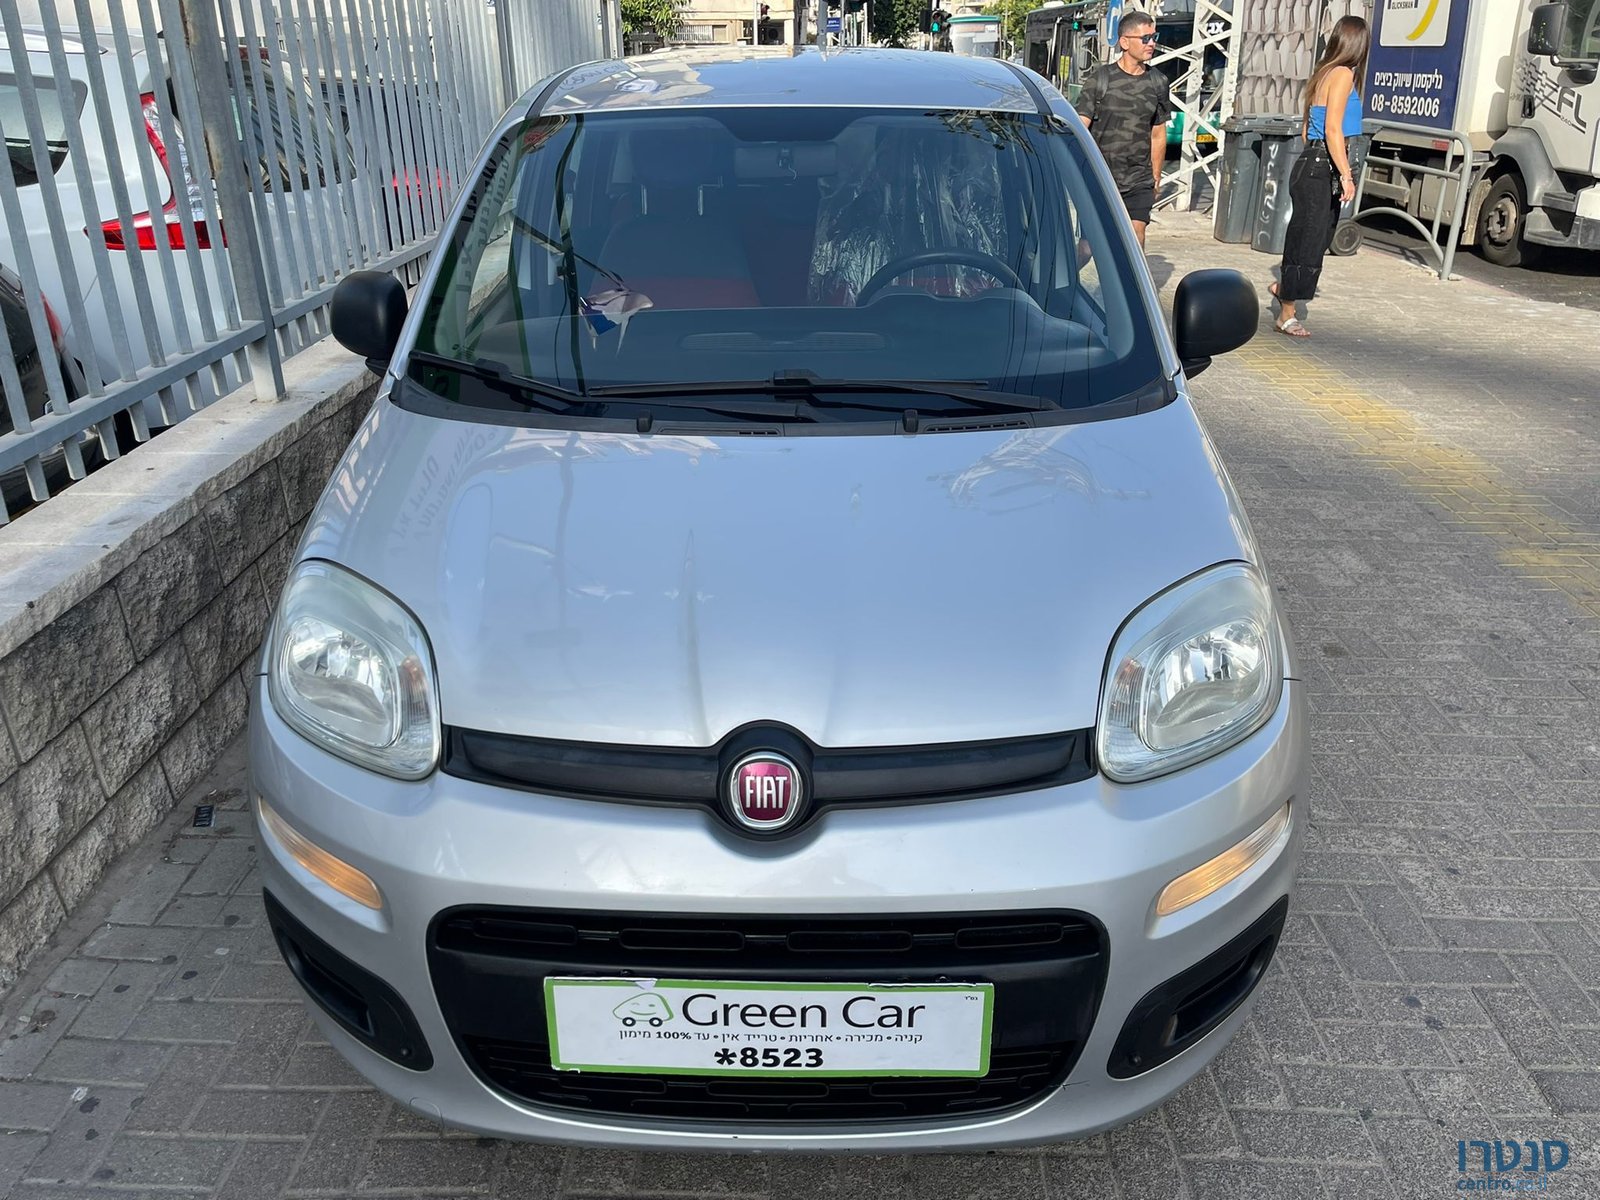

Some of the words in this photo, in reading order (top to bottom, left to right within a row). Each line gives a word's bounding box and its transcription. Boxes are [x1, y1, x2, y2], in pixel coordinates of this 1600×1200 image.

[1374, 72, 1393, 86] ביצים
[1393, 73, 1412, 91] שיווק
[1412, 68, 1443, 93] גליקסמן
[1371, 94, 1440, 117] 08-8592006
[746, 776, 787, 809] FIAT
[681, 993, 828, 1028] Green
[842, 996, 926, 1028] Car
[619, 1030, 651, 1039] מימון
[656, 1031, 692, 1040] 100%
[694, 1032, 710, 1040] עד
[722, 1032, 740, 1043] אין
[744, 1033, 778, 1042] טרייד
[788, 1033, 833, 1043] אחריות
[845, 1034, 883, 1043] מכירה
[895, 1034, 923, 1044] קניה
